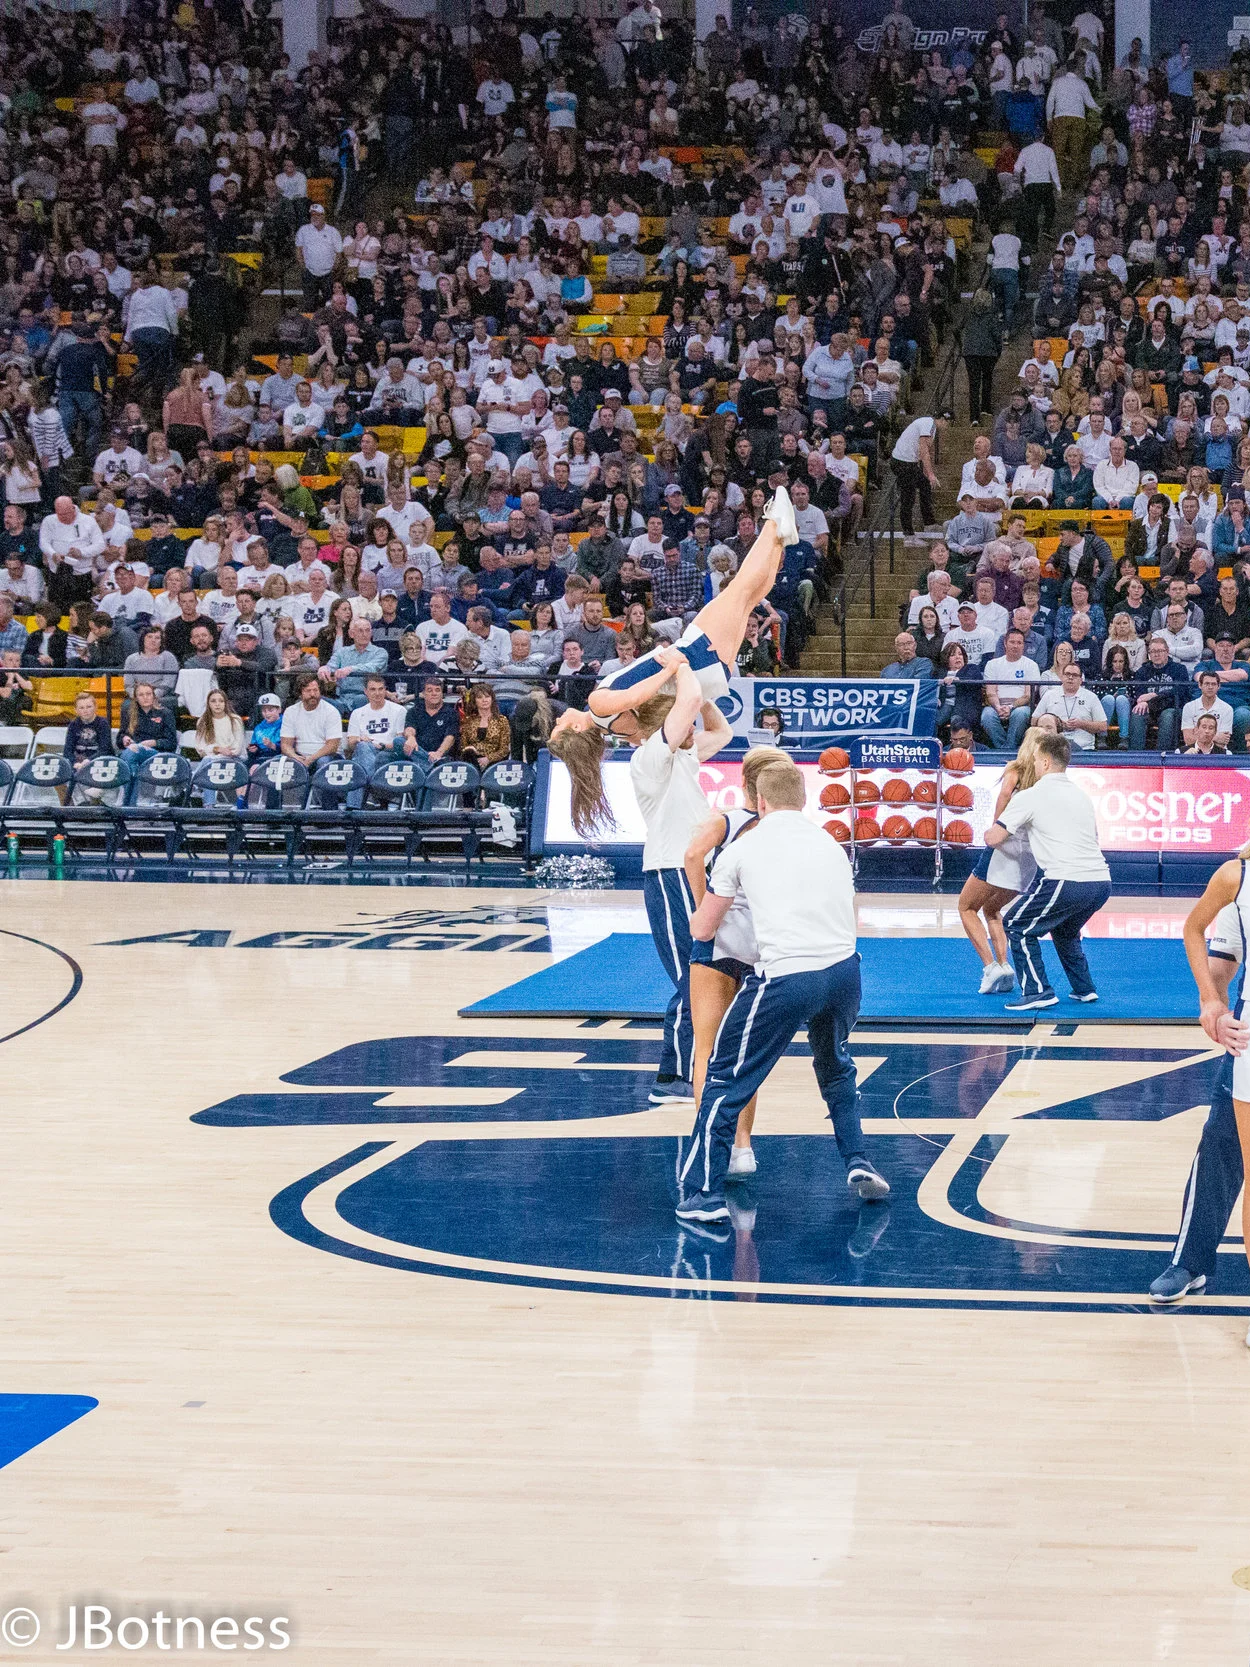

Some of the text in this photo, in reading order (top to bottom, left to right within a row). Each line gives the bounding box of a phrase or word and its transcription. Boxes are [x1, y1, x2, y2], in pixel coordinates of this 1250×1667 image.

[425, 638, 450, 646] STATE
[759, 688, 908, 707] CBS SPORTS
[760, 707, 882, 726] ETWORK
[861, 755, 931, 763] BASKETBALL
[1110, 828, 1212, 843] FOODS
